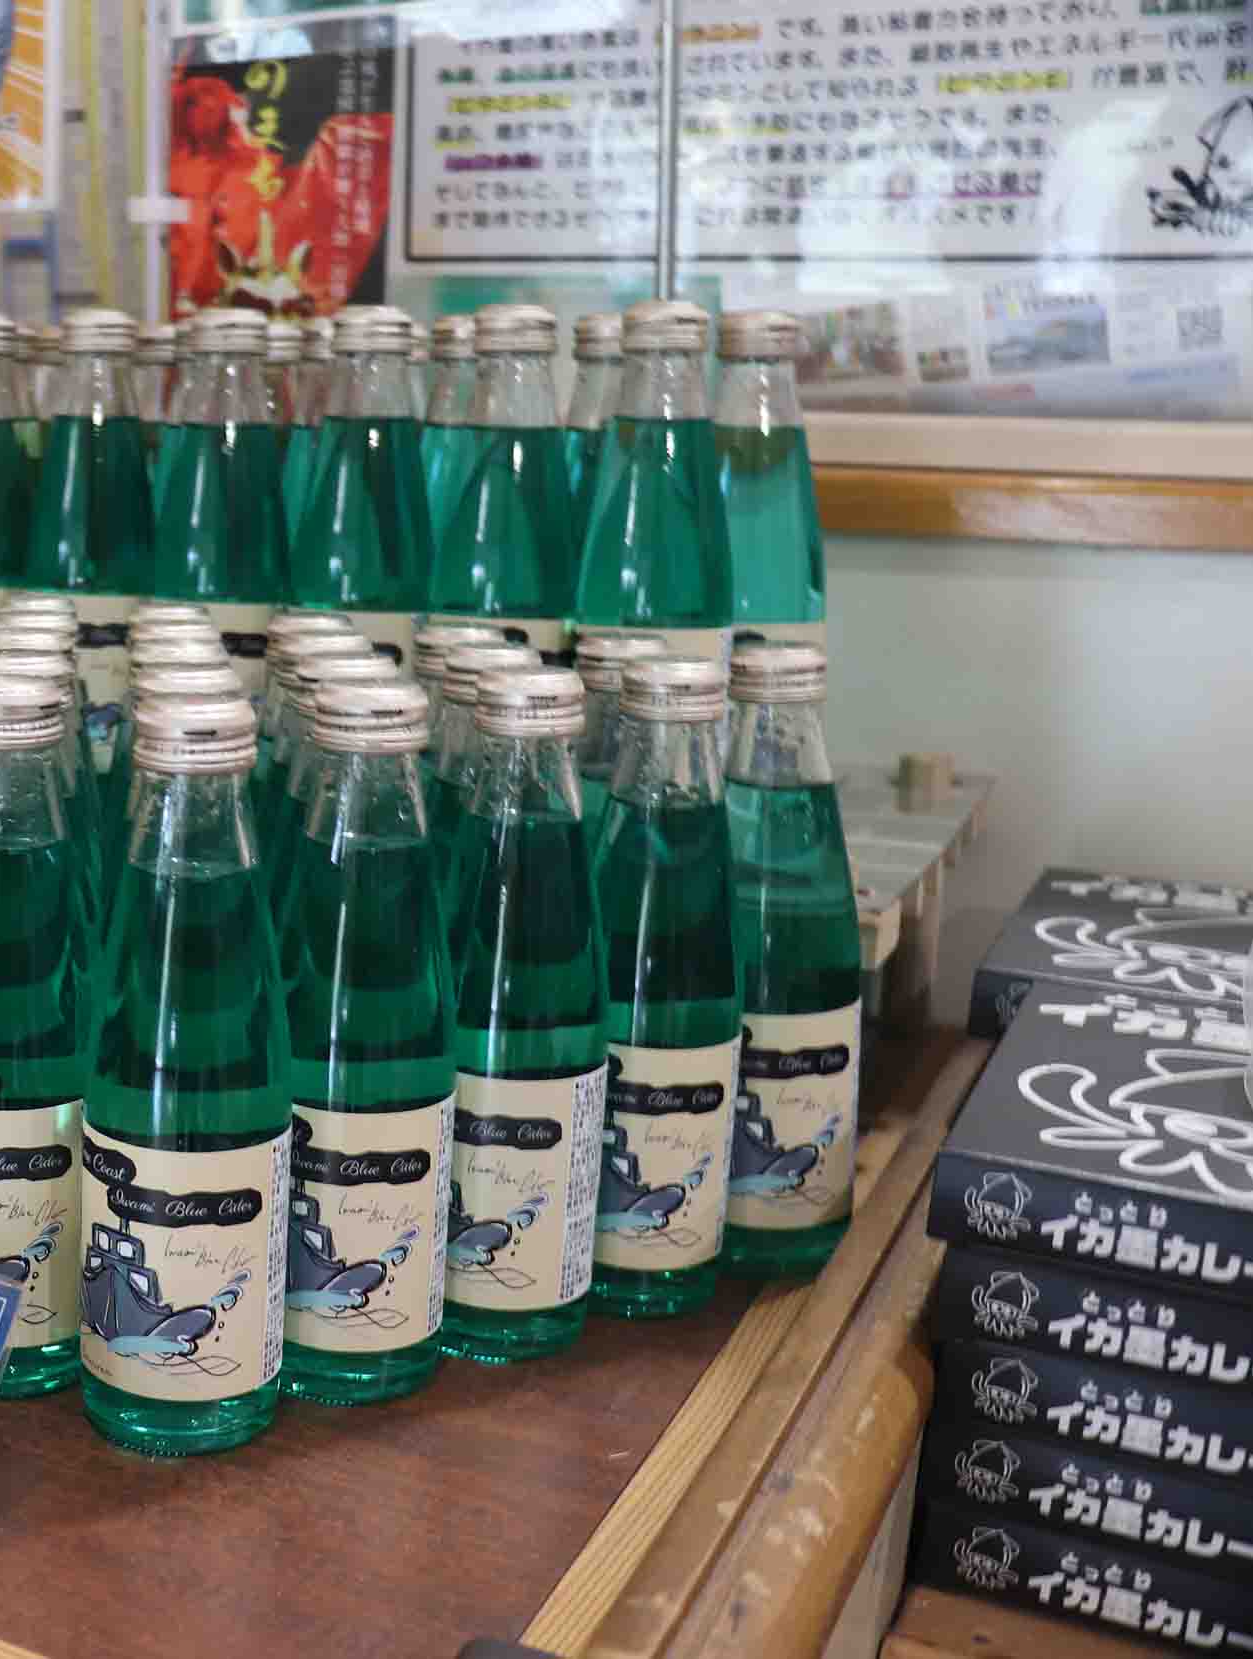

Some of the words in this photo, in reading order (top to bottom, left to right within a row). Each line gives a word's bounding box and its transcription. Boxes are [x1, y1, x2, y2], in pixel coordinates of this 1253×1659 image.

[469, 1120, 508, 1139] Blue
[28, 1153, 64, 1170] Cider
[92, 1152, 126, 1183] Coast
[339, 1158, 380, 1177] Blue
[390, 1157, 423, 1174] Cider
[165, 1198, 209, 1218] Blue
[218, 1198, 253, 1215] Cider
[1075, 1191, 1168, 1229] とっとり
[1082, 1290, 1176, 1330] とっとり
[1080, 1379, 1173, 1419] とっとり
[1061, 1463, 1153, 1501] とっとり
[1060, 1551, 1152, 1592] とっとり
